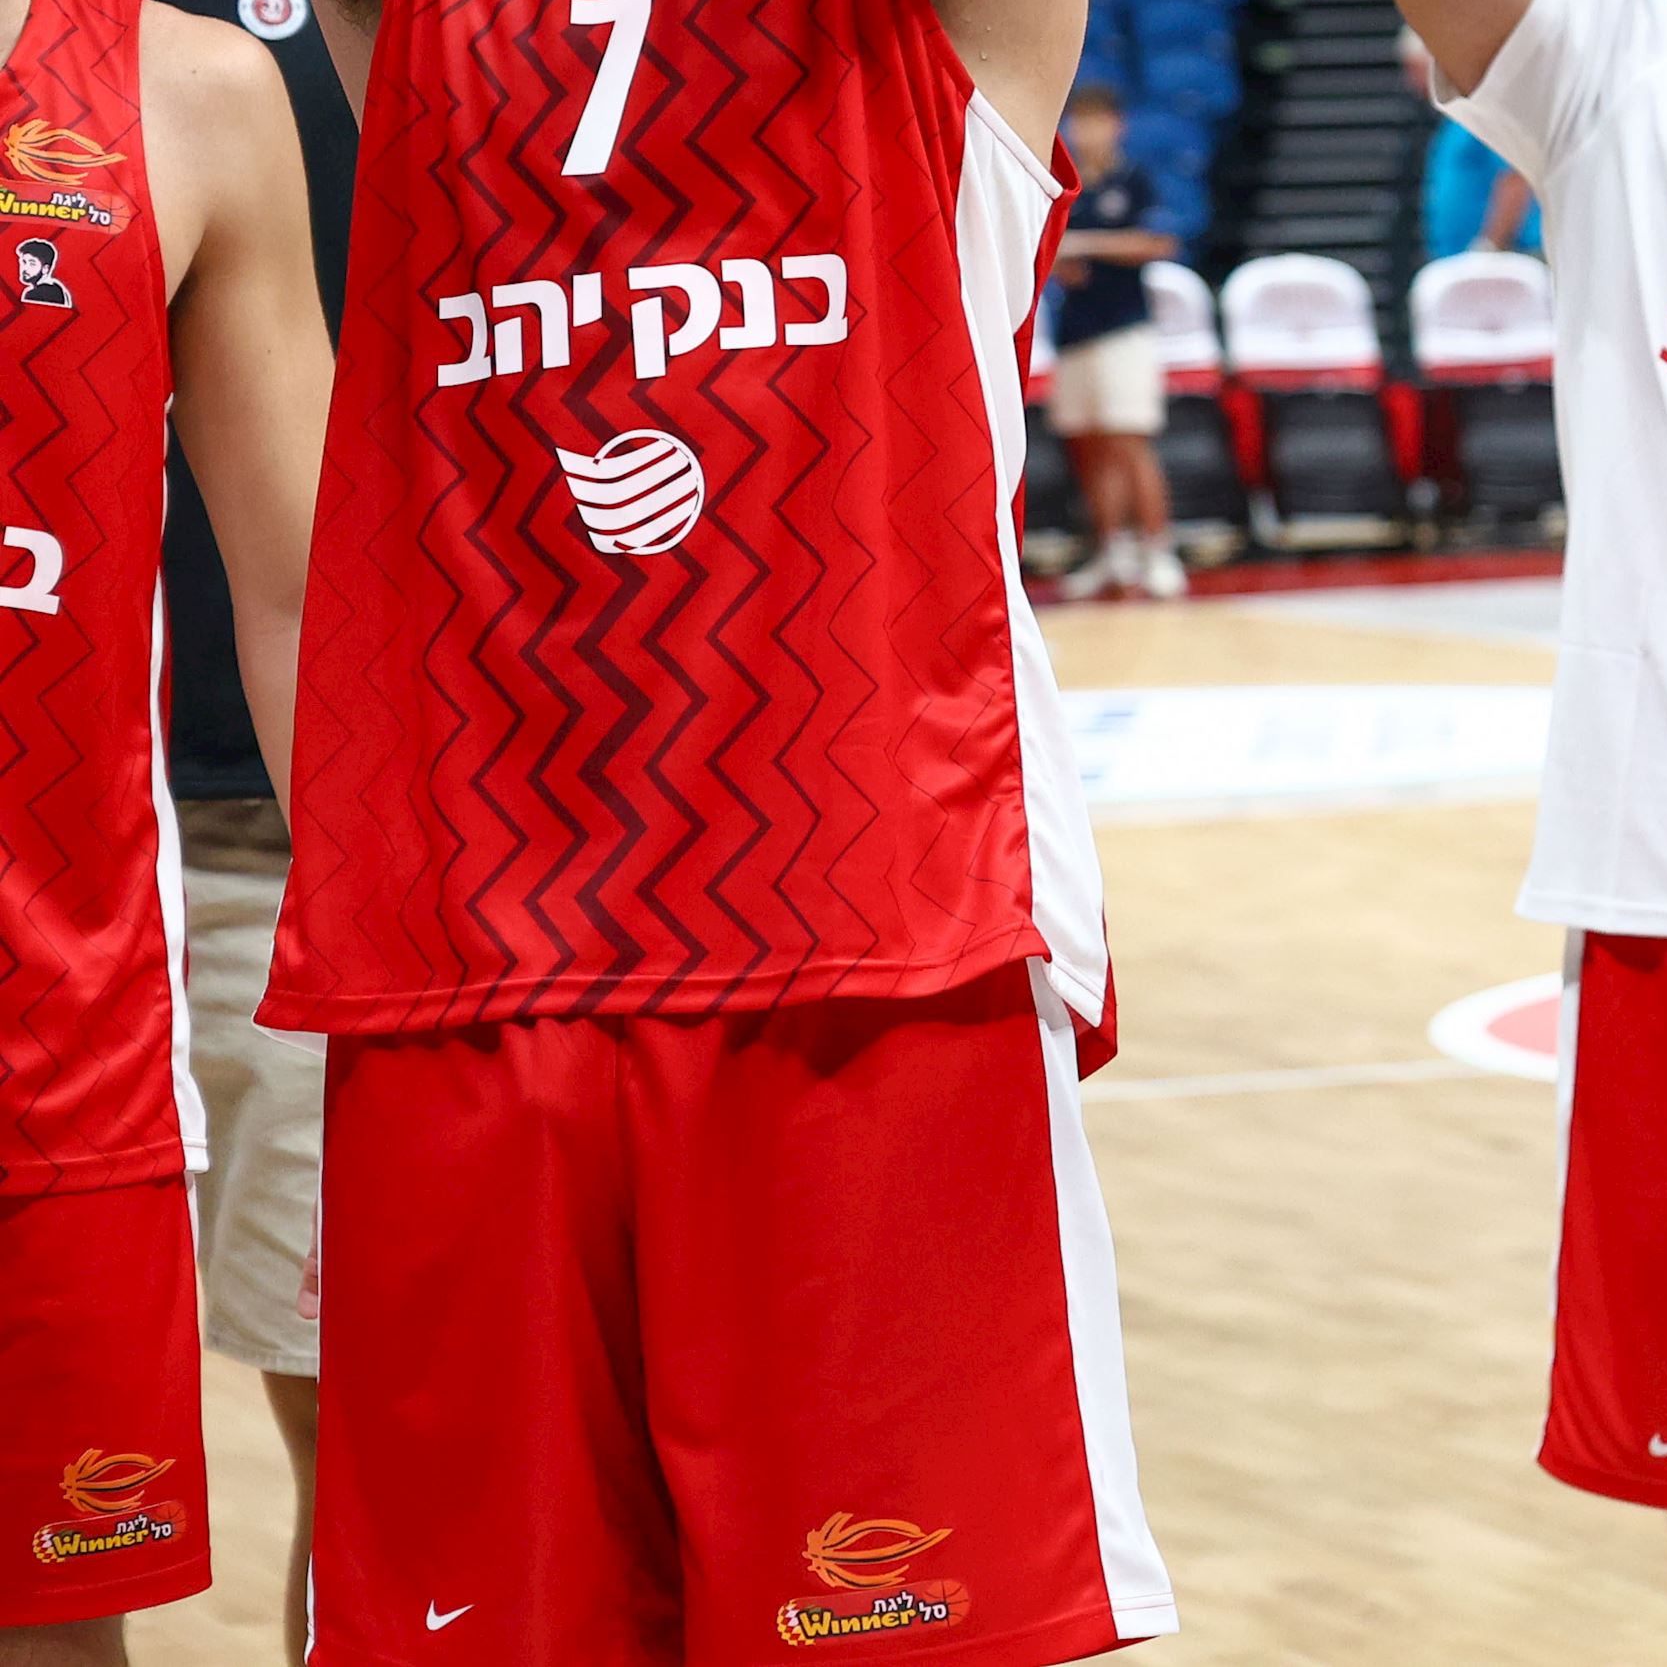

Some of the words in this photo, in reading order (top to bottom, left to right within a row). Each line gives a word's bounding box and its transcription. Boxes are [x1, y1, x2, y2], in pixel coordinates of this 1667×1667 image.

[50, 191, 87, 209] ליגת
[88, 205, 112, 226] סל
[627, 253, 849, 380] בנק
[437, 271, 603, 388] יהב
[115, 1514, 149, 1535] ליגת
[149, 1522, 173, 1540] סל
[52, 1528, 150, 1557] Winner
[872, 1590, 915, 1615] ליגת
[918, 1601, 948, 1622] סל
[799, 1607, 917, 1638] Winner
